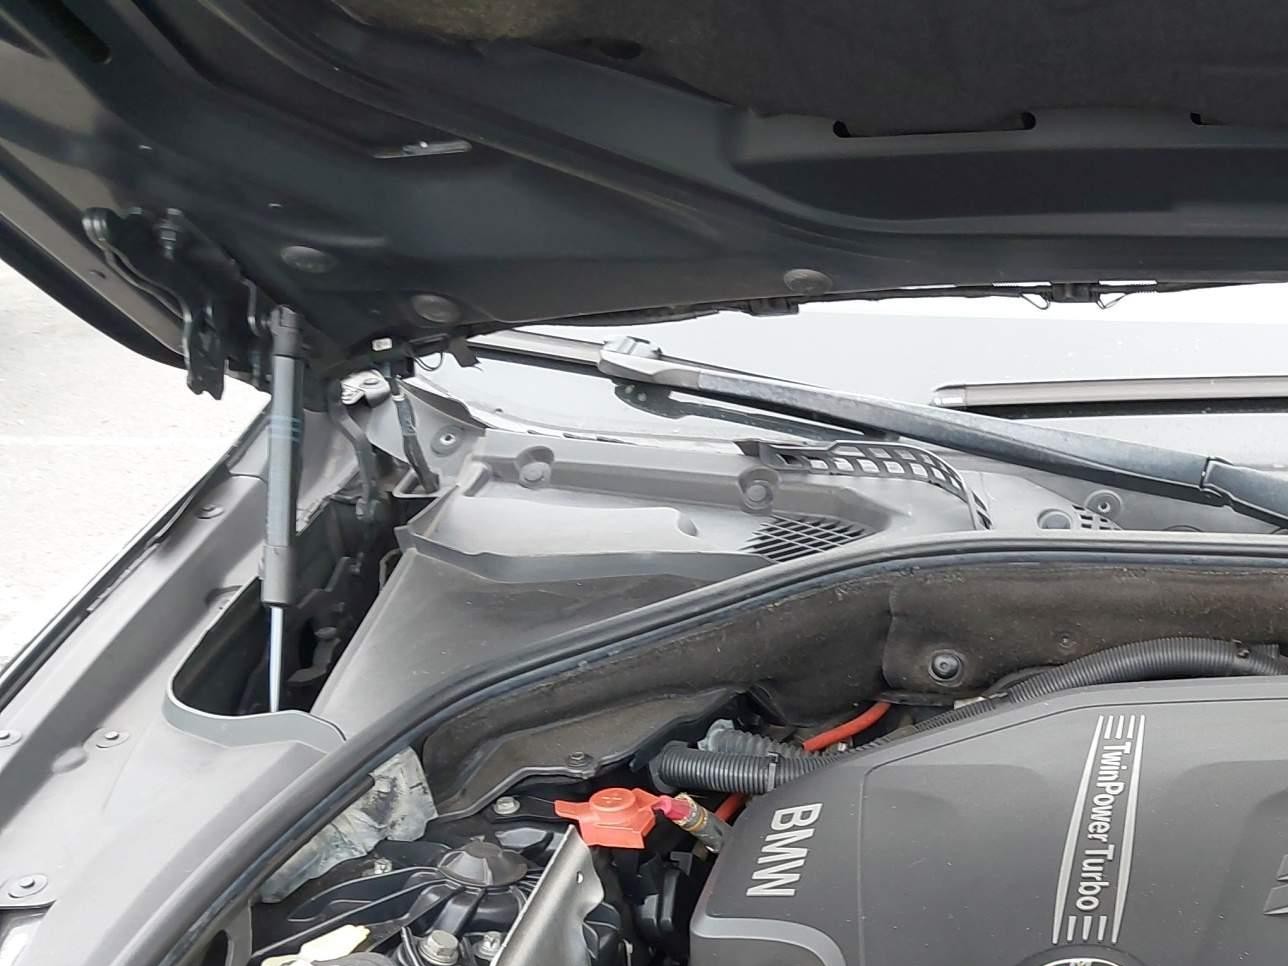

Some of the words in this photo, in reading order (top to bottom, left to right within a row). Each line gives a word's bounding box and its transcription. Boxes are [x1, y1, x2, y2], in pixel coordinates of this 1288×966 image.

[1086, 740, 1132, 842] TwinPower
[746, 803, 823, 896] BMW
[1075, 844, 1115, 911] Turbo
